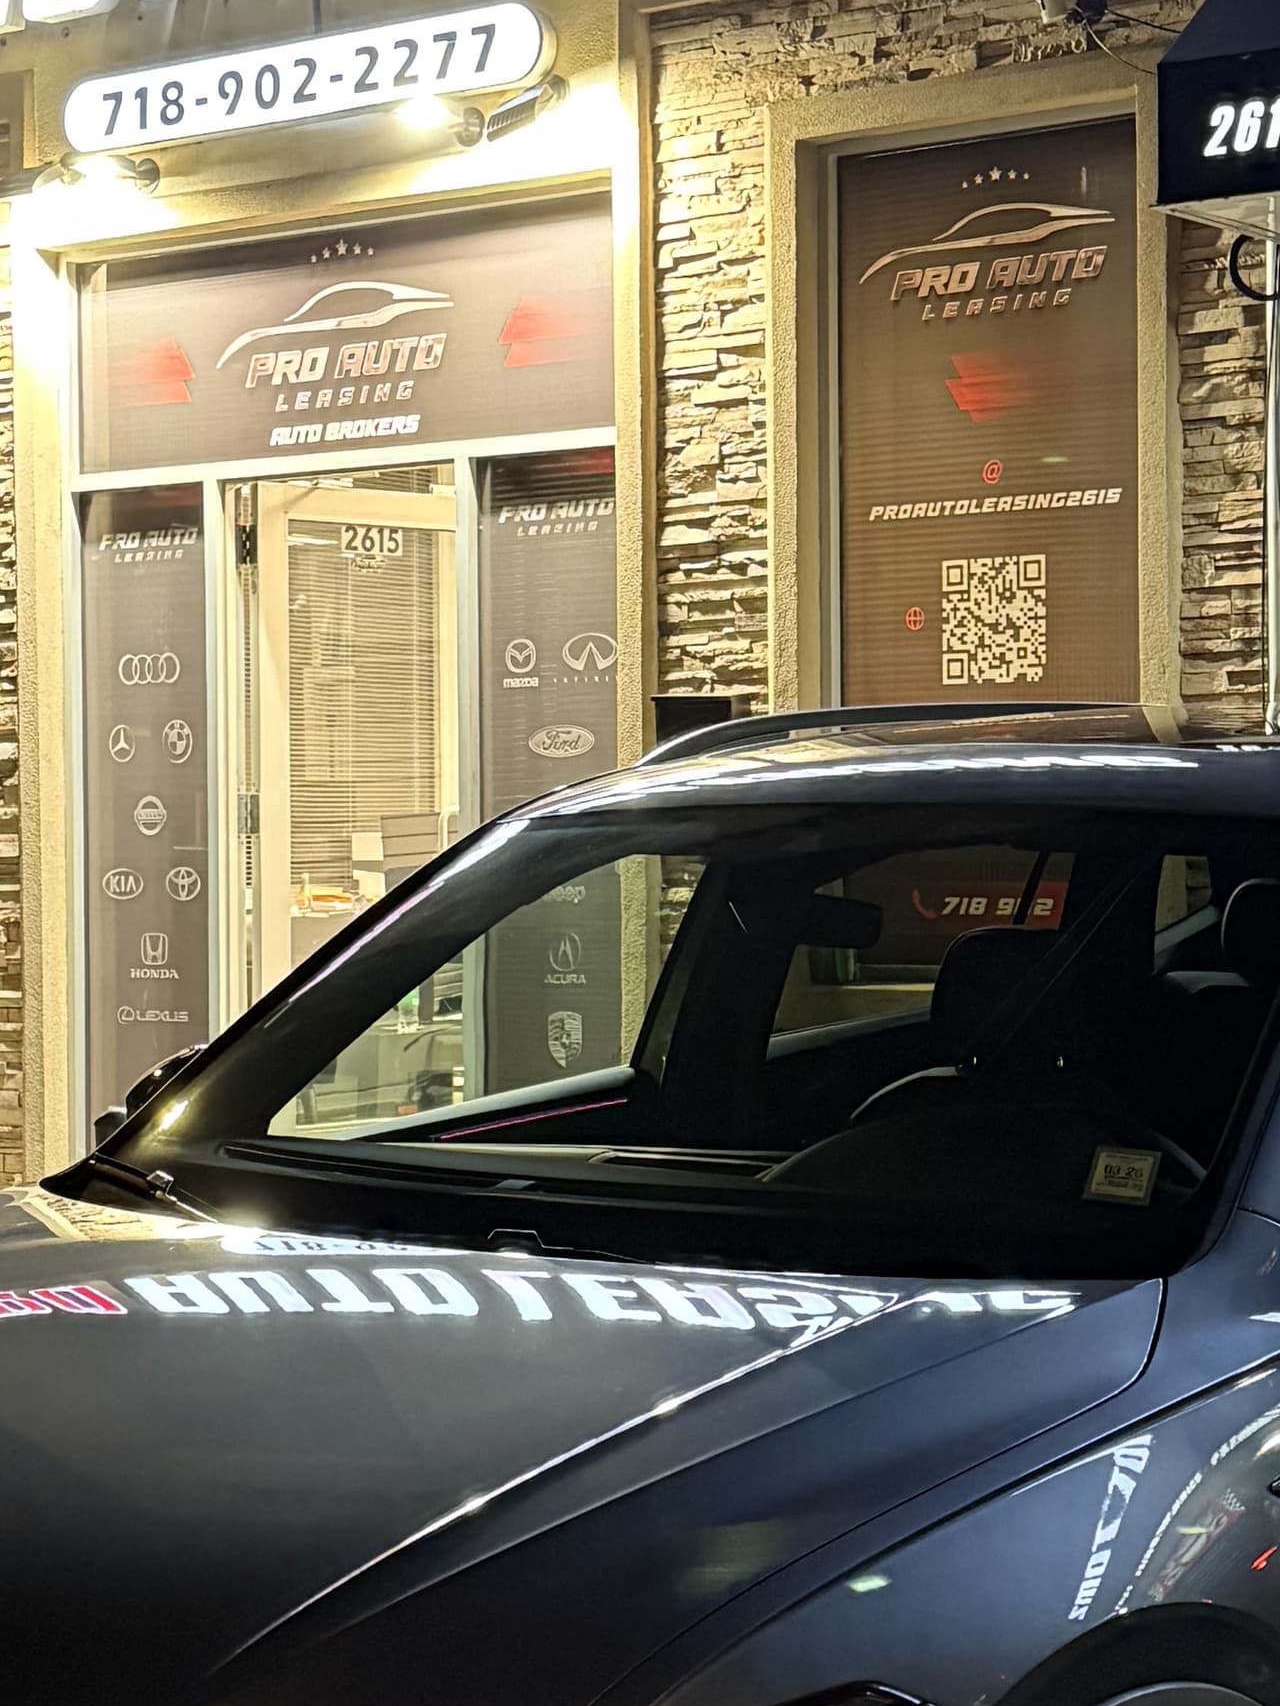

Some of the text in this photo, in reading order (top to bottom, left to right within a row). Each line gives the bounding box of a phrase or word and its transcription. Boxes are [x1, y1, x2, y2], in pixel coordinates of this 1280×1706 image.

[103, 23, 498, 135] 718-902-2277
[889, 245, 1108, 302] PRO AUTO
[921, 288, 1072, 321] LEASING
[245, 333, 447, 388] PRO AUTO
[275, 380, 415, 412] LEASING
[270, 414, 421, 446] AUTO BROKERS
[499, 497, 616, 524] PRO AUTO
[869, 488, 1122, 520] PROAUTOLEASING2615
[99, 527, 199, 551] PRO AUTO
[344, 525, 400, 553] 2615
[542, 730, 581, 751] Ford
[110, 875, 137, 893] KIA
[941, 897, 1055, 917] 718 92
[130, 968, 179, 980] HONDA
[544, 973, 587, 985] ACURA
[136, 1010, 189, 1022] LEXUS
